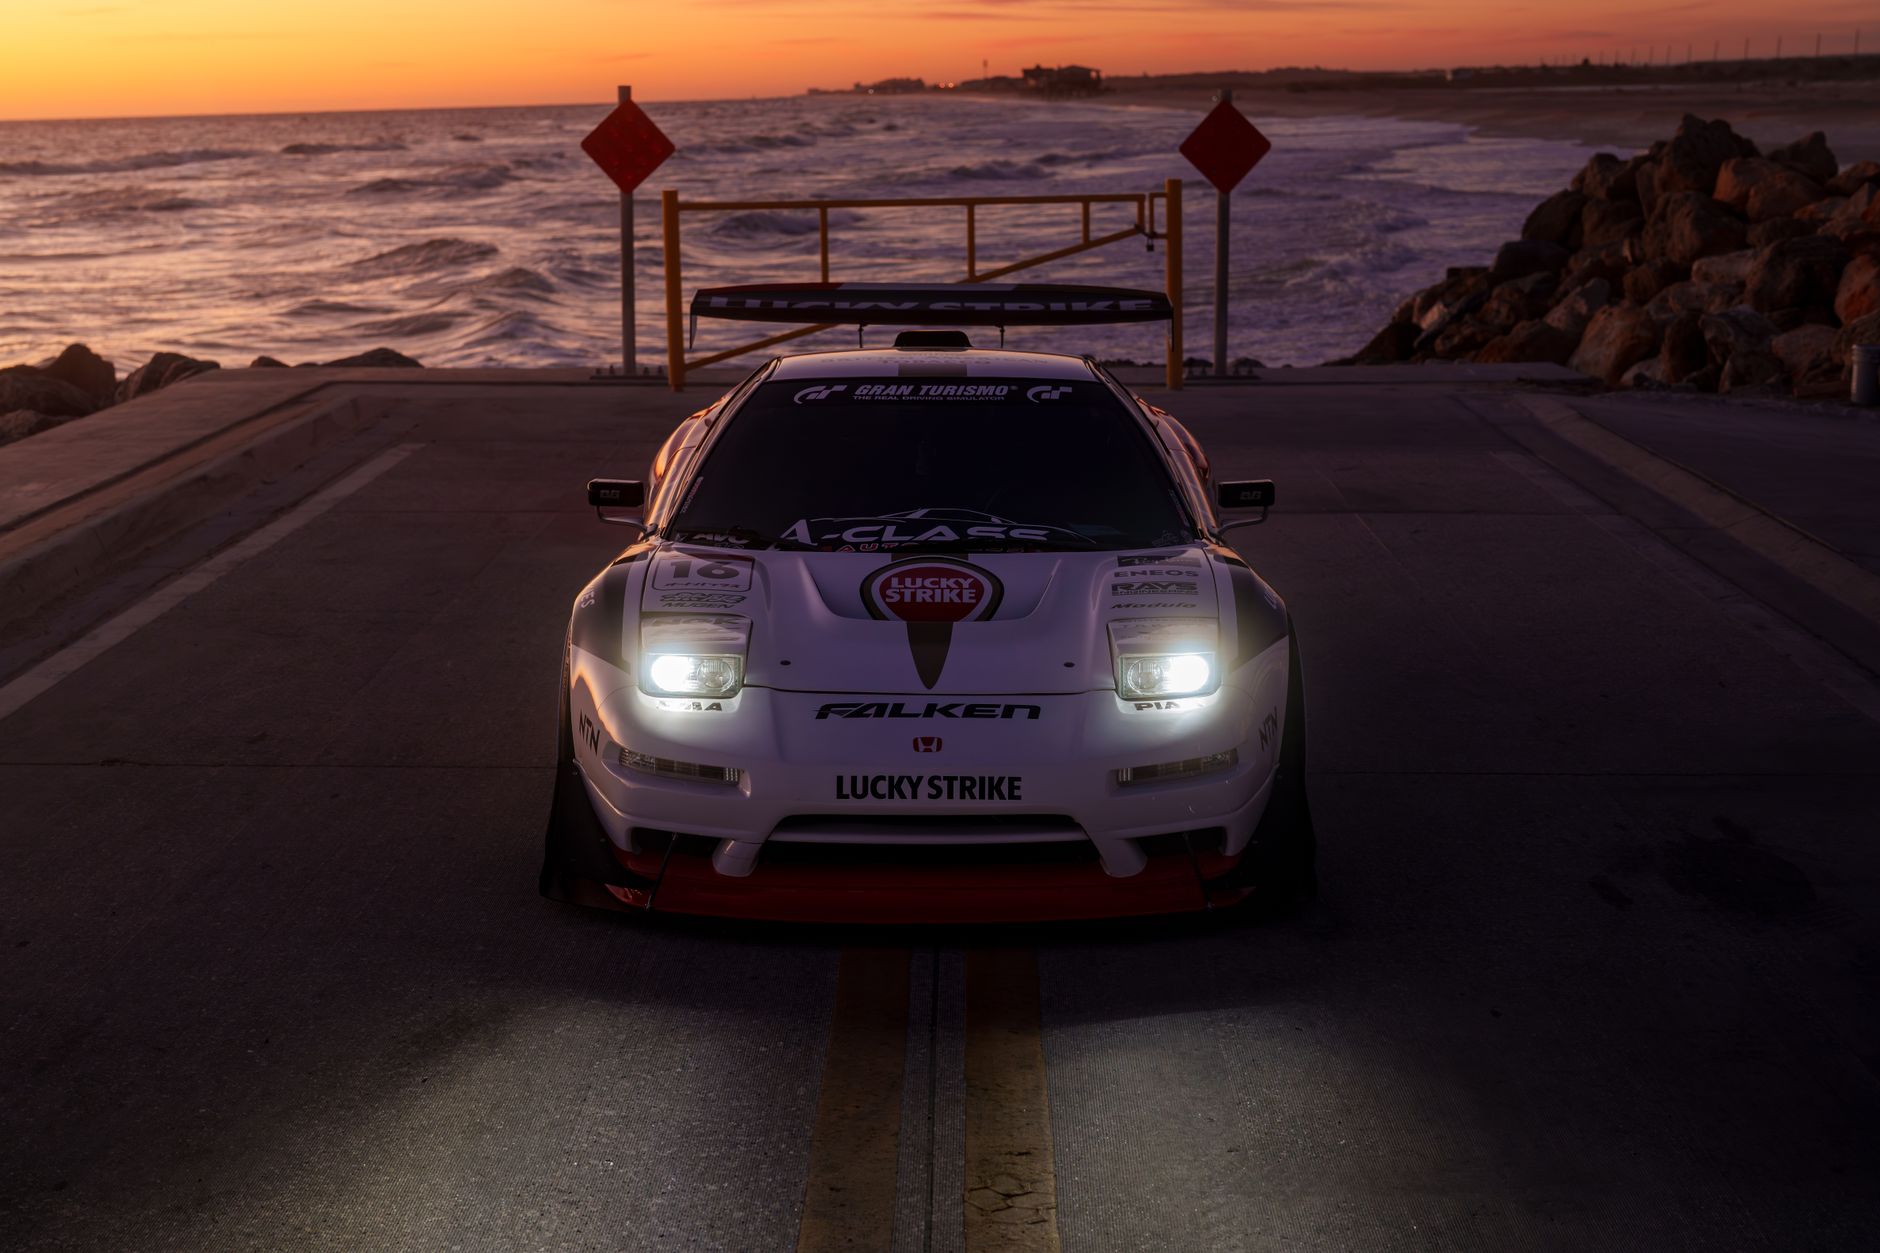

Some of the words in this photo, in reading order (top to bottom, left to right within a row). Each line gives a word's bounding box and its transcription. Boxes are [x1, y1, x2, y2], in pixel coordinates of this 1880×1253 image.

[854, 384, 915, 396] GRAN
[919, 384, 1009, 396] TURISMO
[780, 518, 1051, 546] A-CLASS
[670, 561, 740, 580] 16
[1114, 569, 1199, 577] ENEOS
[891, 577, 975, 589] LUCKY
[1111, 582, 1197, 592] RAYS
[885, 588, 977, 604] STRIKE
[815, 703, 1041, 720] FALKEN
[578, 711, 600, 756] NTN
[1258, 706, 1279, 752] NTN
[836, 775, 923, 800] LUCKY
[927, 775, 1022, 801] STRIKE
